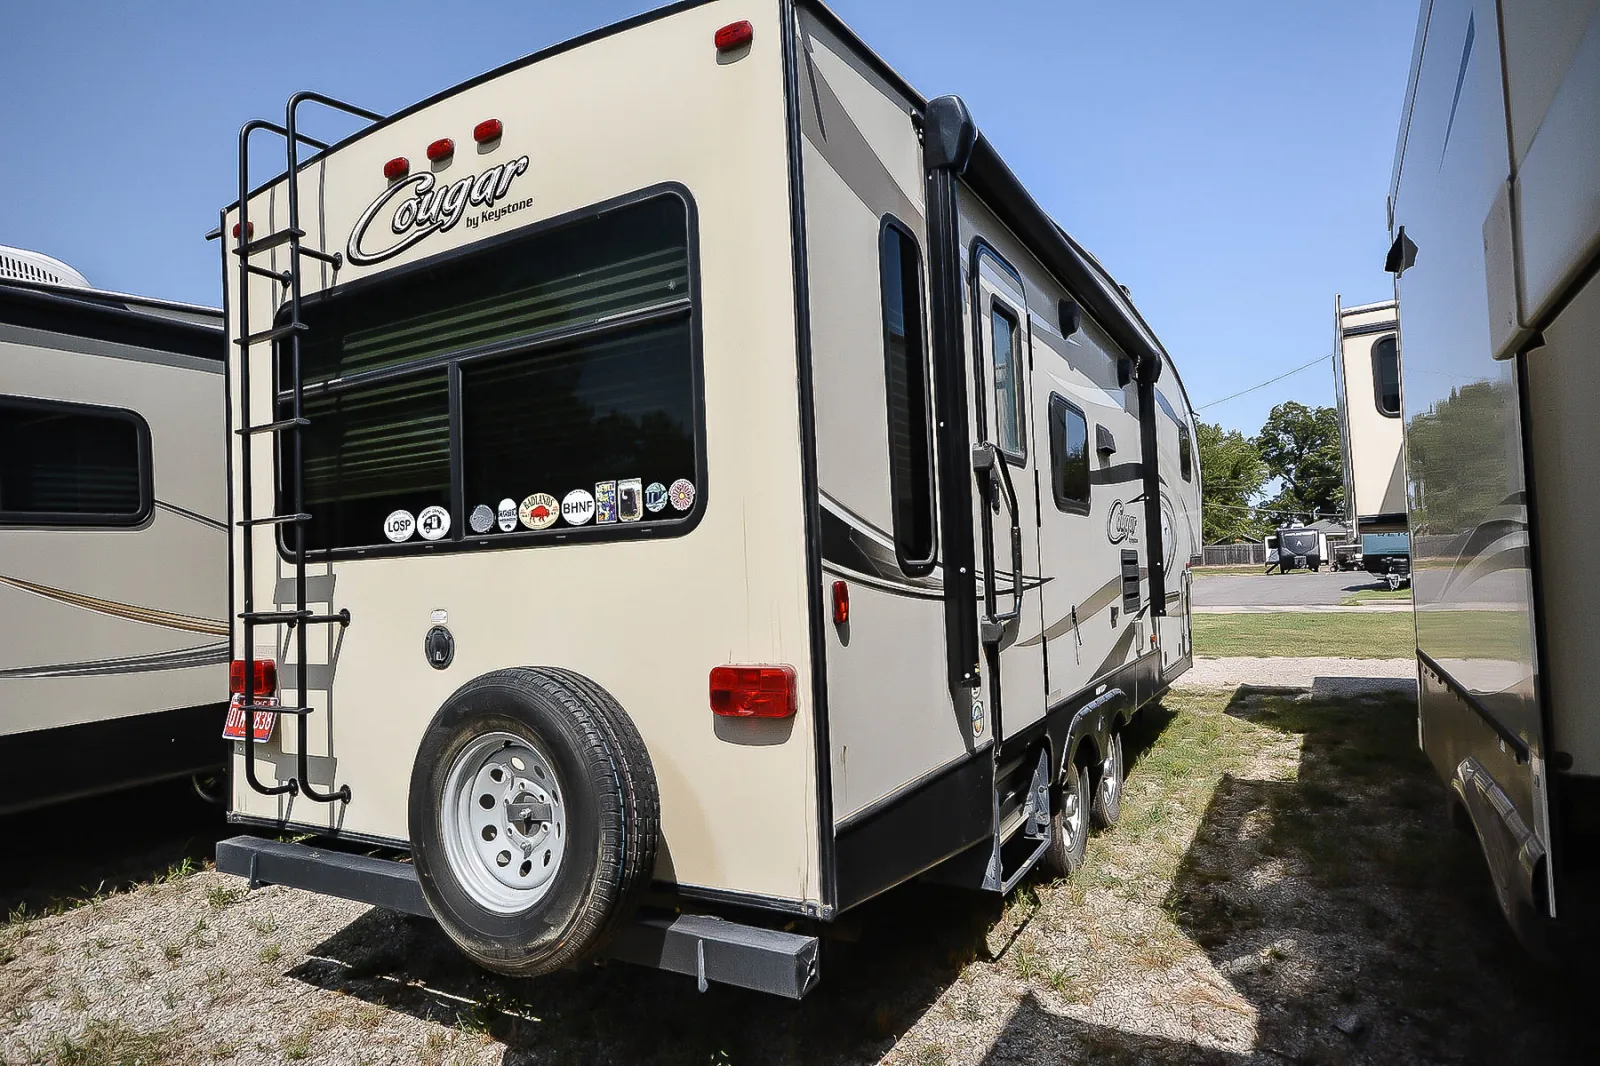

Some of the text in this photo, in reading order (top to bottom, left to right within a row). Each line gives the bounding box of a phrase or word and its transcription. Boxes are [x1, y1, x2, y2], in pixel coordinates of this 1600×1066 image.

[347, 155, 529, 266] Cougar
[466, 198, 533, 228] by Keystone
[563, 500, 593, 514] BHNF
[1107, 499, 1137, 544] Cougar
[388, 519, 411, 533] LOSP
